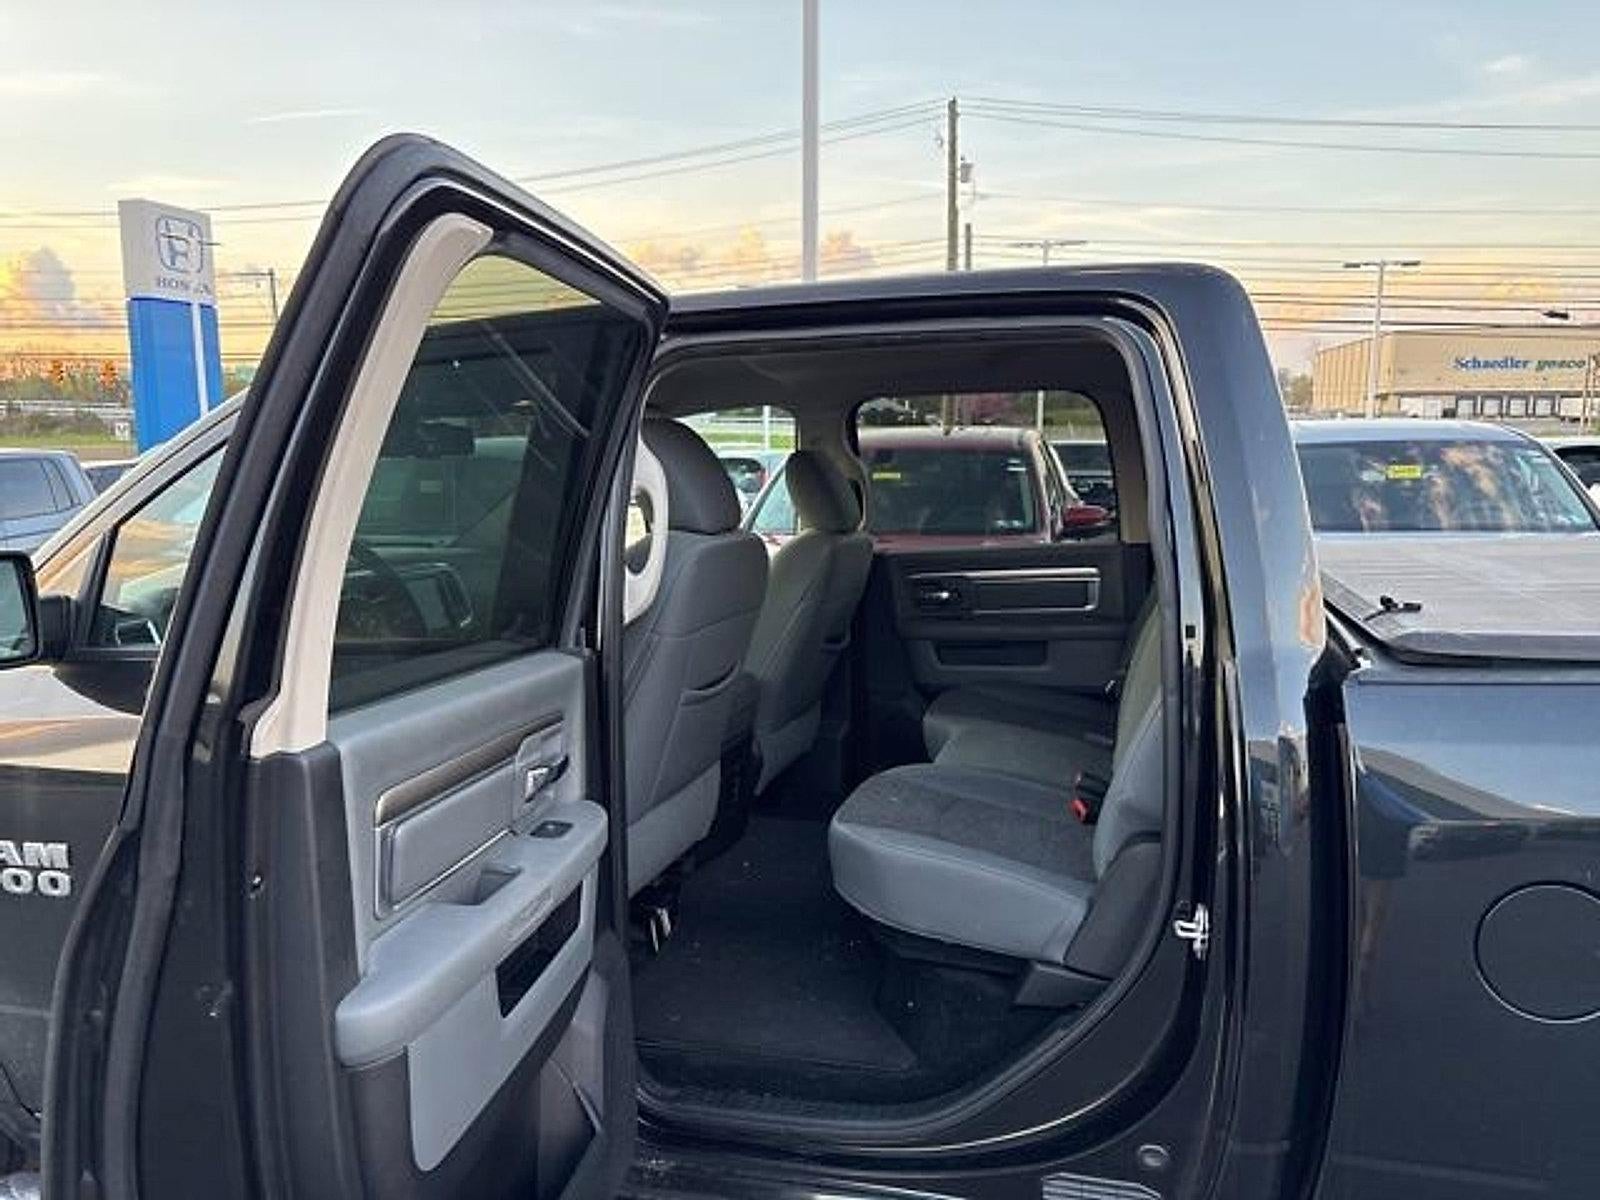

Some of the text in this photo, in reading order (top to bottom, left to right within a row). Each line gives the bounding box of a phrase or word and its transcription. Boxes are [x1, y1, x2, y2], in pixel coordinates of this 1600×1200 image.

[157, 277, 212, 295] HONA
[1453, 356, 1530, 370] Schaedler
[0, 840, 69, 869] AM
[0, 867, 71, 897] 00
